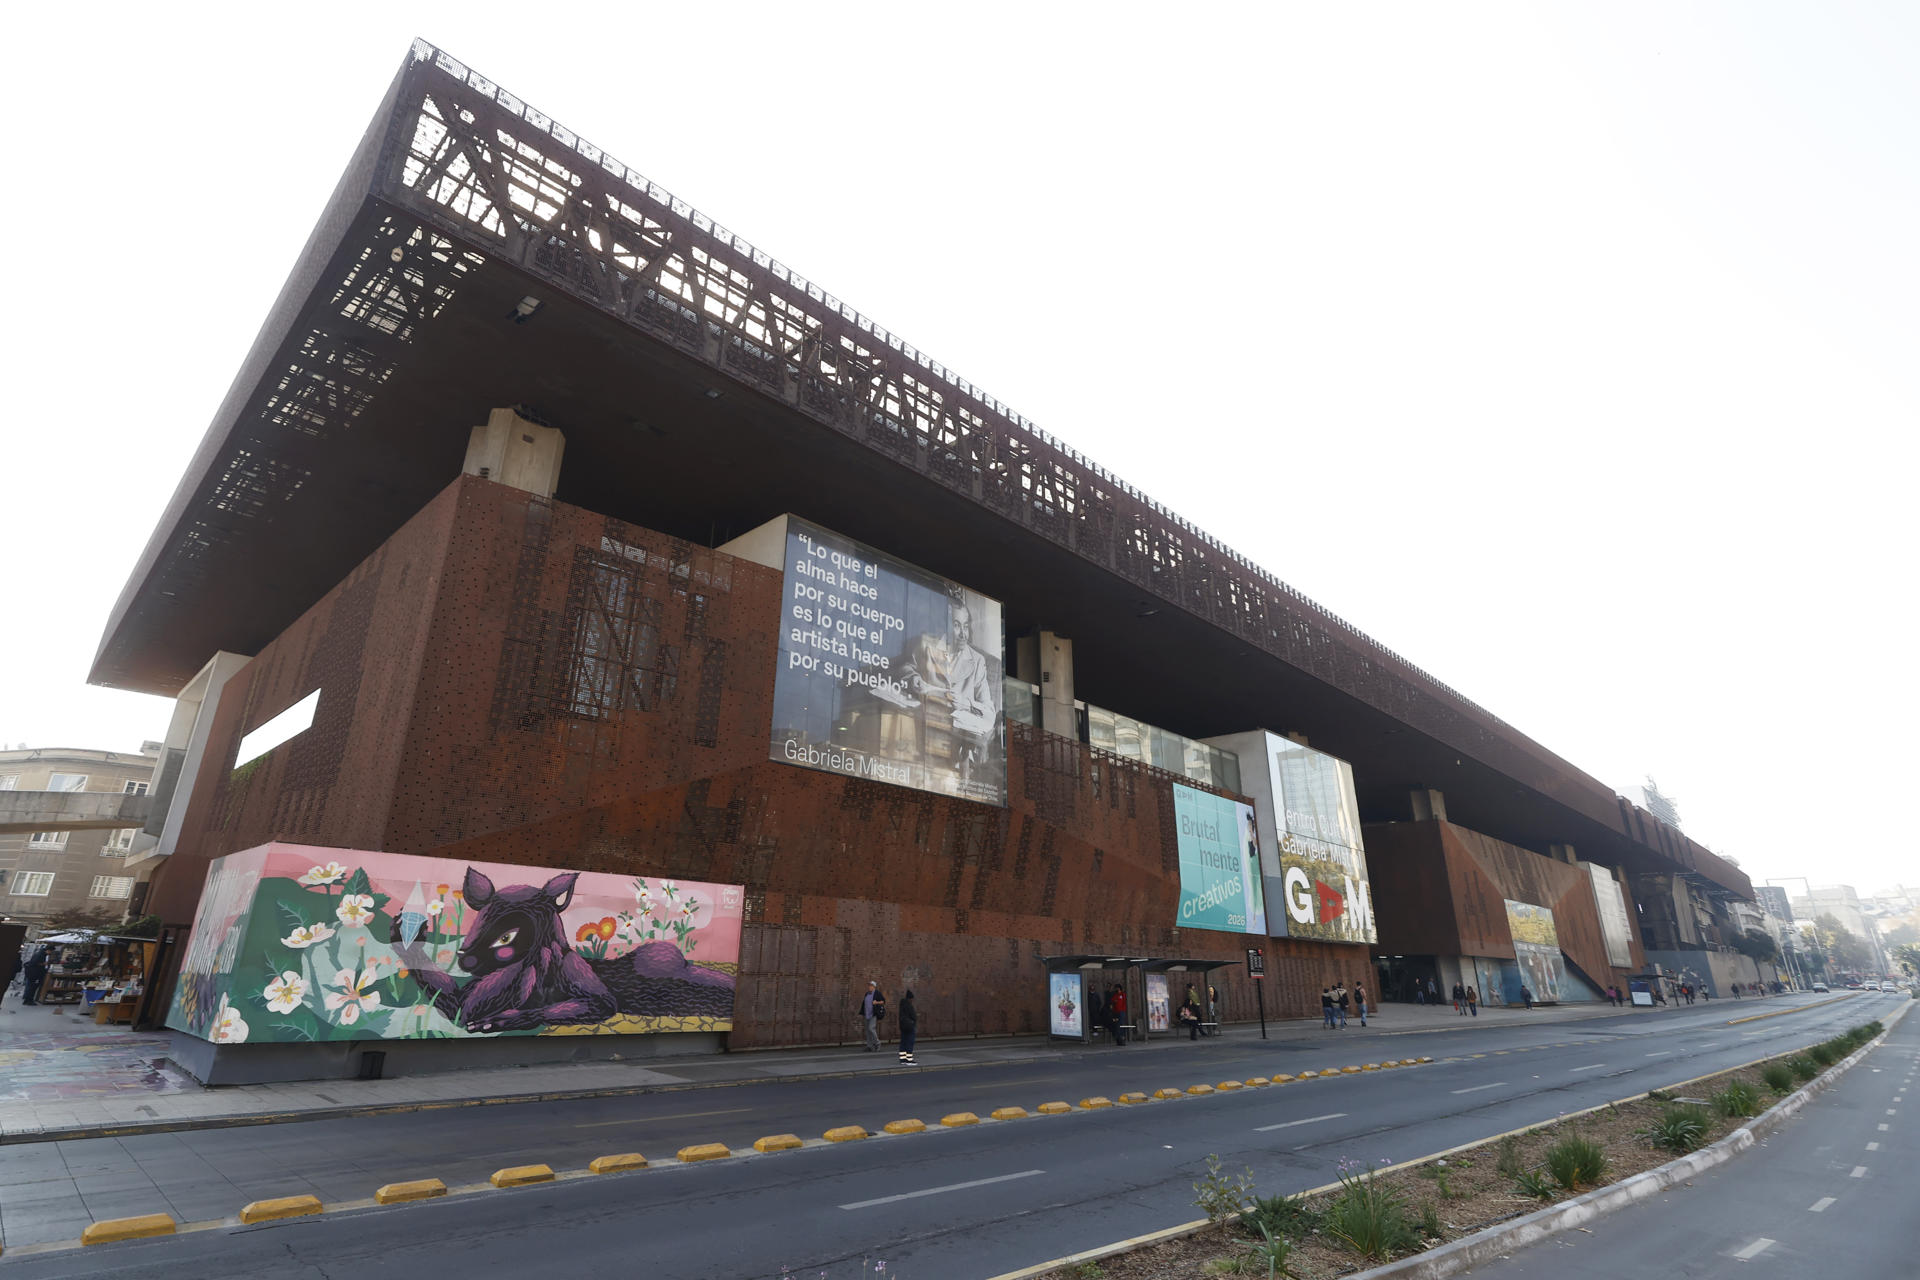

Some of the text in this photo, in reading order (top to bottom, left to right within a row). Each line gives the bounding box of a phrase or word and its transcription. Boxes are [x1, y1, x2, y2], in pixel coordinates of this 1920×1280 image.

[799, 533, 878, 579] “Lo que el
[796, 559, 879, 600] alma hace
[792, 604, 884, 645] es lo que el
[794, 582, 905, 631] por su cuerpo
[789, 651, 820, 671] por
[823, 660, 843, 679] su
[791, 626, 890, 669] artista hace
[784, 739, 910, 785] Gabriela Mistral
[1181, 814, 1220, 842] Brutal
[1286, 809, 1317, 832] entro
[1201, 849, 1240, 873] mente
[1280, 832, 1327, 861] Gabriela
[1183, 876, 1242, 919] creativos
[1227, 913, 1246, 926] 2026
